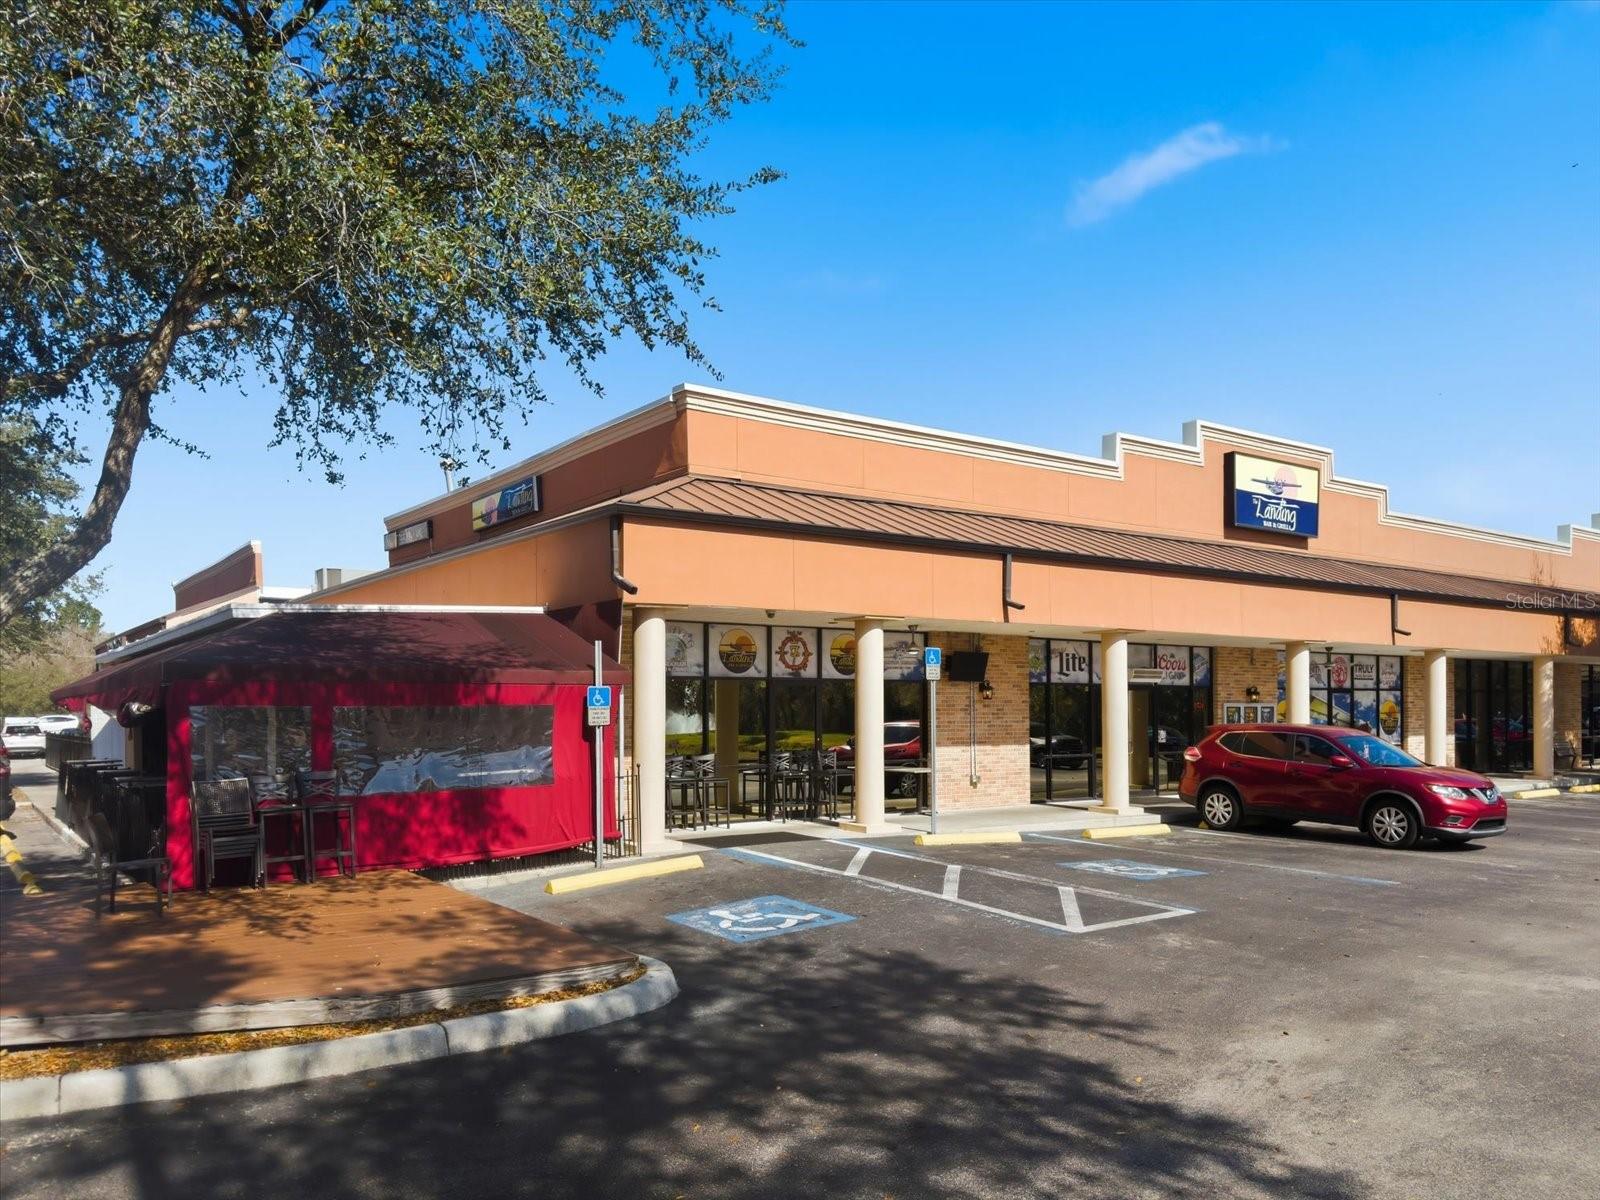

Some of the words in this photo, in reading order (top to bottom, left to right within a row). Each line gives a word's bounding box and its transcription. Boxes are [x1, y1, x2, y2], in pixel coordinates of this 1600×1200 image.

[1256, 498, 1297, 531] Landing
[1057, 651, 1088, 677] Lite
[1157, 653, 1187, 671] Coors
[1354, 663, 1374, 674] TRULY
